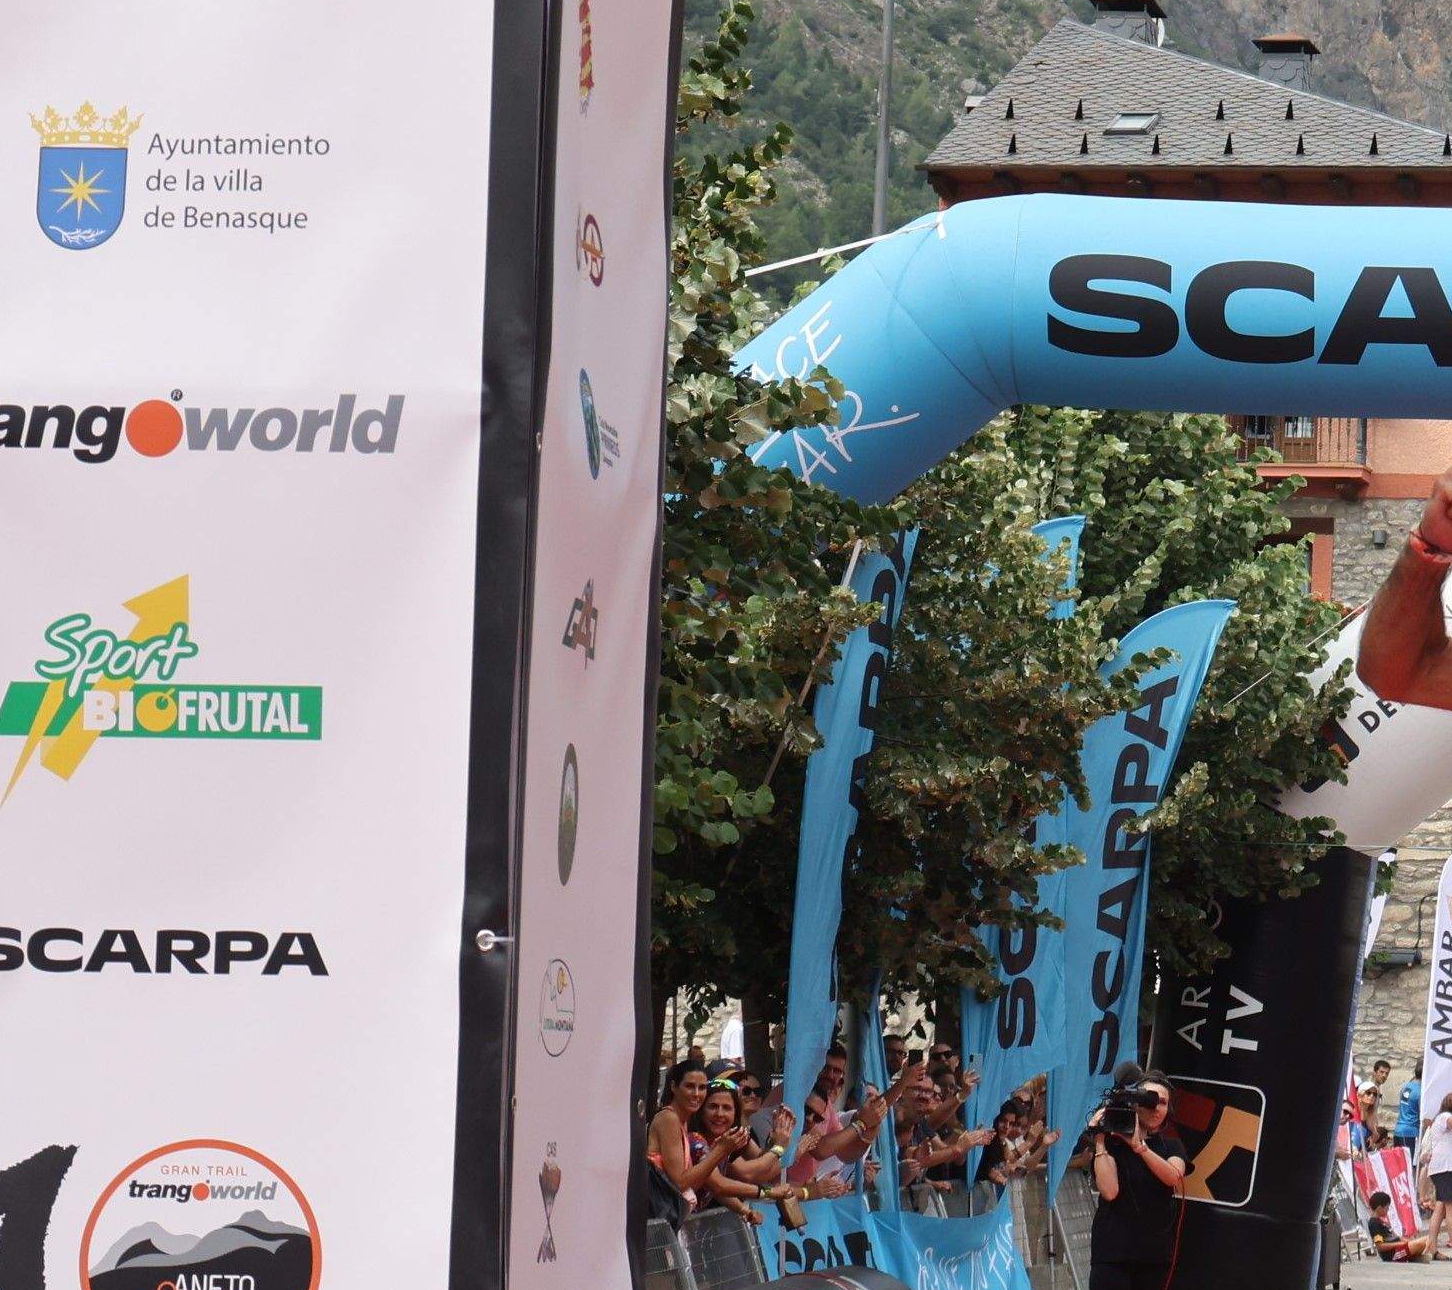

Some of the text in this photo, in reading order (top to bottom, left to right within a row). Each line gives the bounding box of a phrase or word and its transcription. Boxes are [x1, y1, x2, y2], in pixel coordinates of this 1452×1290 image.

[147, 133, 331, 159] Ayuntamiento
[146, 170, 263, 193] de la villa
[144, 206, 308, 235] de Benasque
[35, 613, 198, 698] Sport
[1221, 985, 1264, 1055] TV
[160, 1164, 247, 1177] GRAN TRAIL
